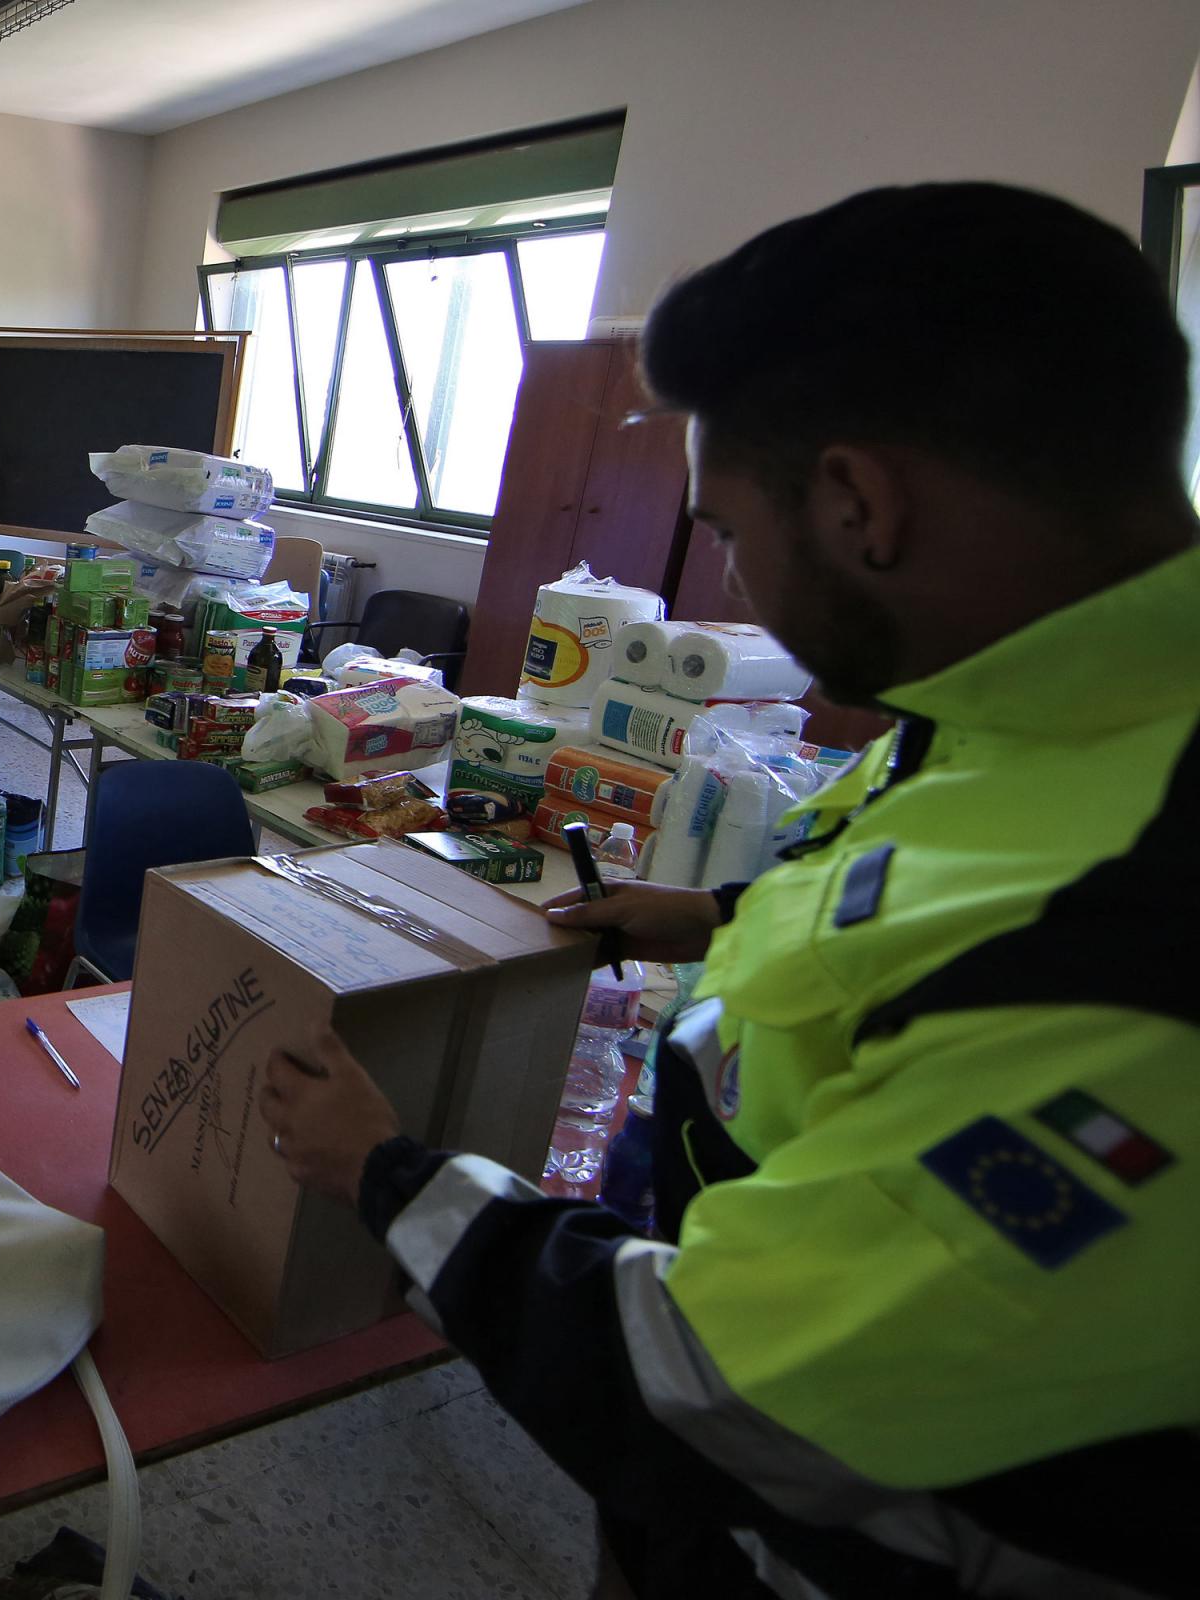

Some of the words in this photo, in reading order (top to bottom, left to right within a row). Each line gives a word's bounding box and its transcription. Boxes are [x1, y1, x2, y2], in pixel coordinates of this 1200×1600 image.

[583, 625, 607, 638] 500
[576, 768, 596, 801] Gently
[693, 783, 718, 832] BICCHIERI
[133, 1056, 191, 1150] SENZA
[186, 967, 265, 1065] GLUTINE
